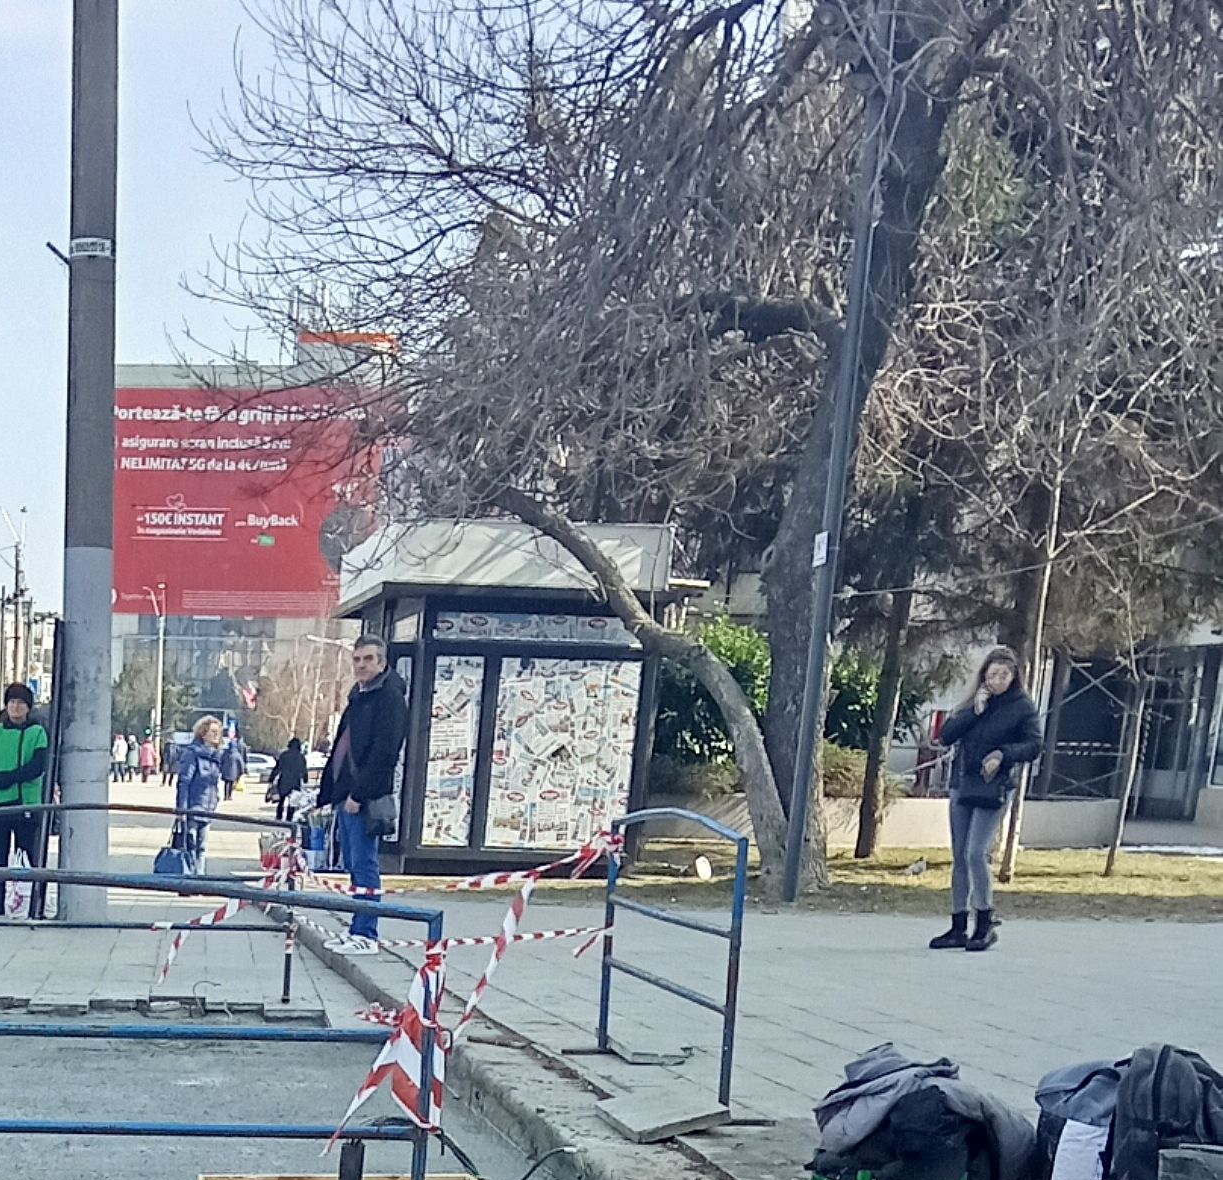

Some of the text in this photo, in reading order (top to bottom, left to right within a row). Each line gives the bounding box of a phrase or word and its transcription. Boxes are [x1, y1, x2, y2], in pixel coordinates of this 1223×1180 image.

[121, 457, 187, 470] NELIMITAT
[174, 512, 225, 526] INSTANT
[247, 513, 299, 529] BuyBack
